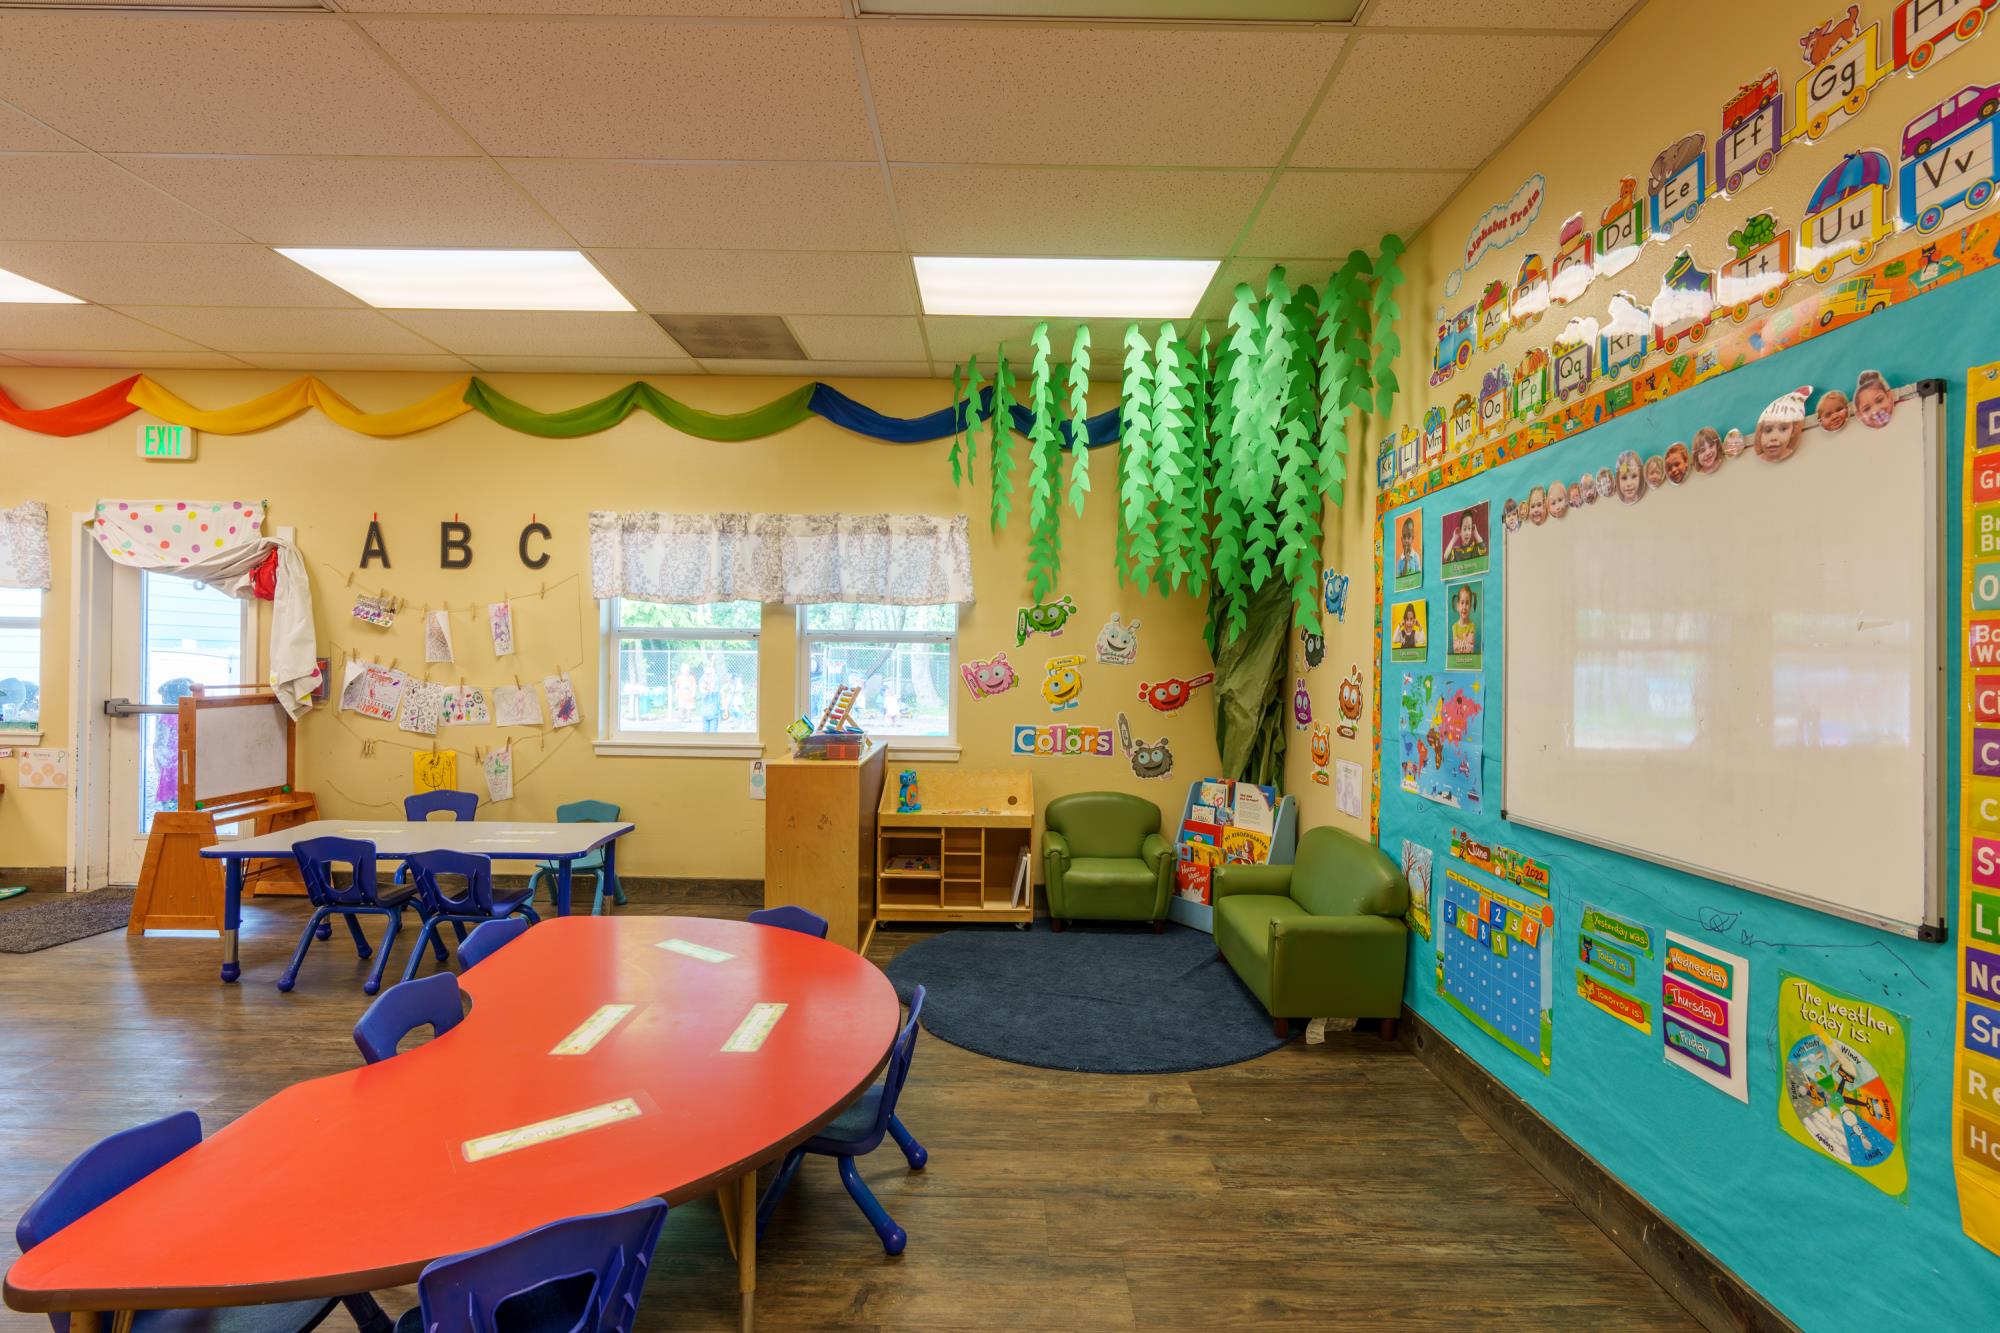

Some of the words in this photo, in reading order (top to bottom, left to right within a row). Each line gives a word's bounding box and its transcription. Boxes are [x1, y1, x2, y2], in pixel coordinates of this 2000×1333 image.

[1914, 0, 1959, 33] H
[1811, 60, 1856, 101] Gg
[1734, 115, 1764, 159] Ff
[1922, 148, 1974, 188] Vv
[1664, 178, 1690, 210] Ee
[1606, 212, 1632, 250] Dd
[1819, 207, 1864, 243] Uu
[1560, 357, 1585, 380] Qq
[1520, 378, 1537, 404] Pp
[1484, 400, 1501, 418] Oo
[1455, 415, 1471, 436] Nn
[145, 425, 184, 456] EXIT
[1382, 456, 1392, 474] Kk
[359, 522, 391, 569] A
[441, 522, 473, 569] B
[518, 522, 552, 570] C
[1017, 729, 1112, 754] Colors
[1232, 831, 1268, 850] KINDERGARTEN
[1468, 842, 1488, 859] June
[1525, 865, 1545, 881] 2022
[1594, 915, 1628, 939] Yesterday
[1596, 949, 1617, 968] Today
[1671, 951, 1728, 989] Wednesday
[1596, 988, 1629, 1012] Tomorrow
[1670, 988, 1718, 1025] Thursday
[1793, 982, 1821, 1006] The
[1827, 1002, 1895, 1036] weather
[1800, 1003, 1844, 1038] today
[1849, 1023, 1872, 1044] is:
[1679, 1031, 1710, 1059] Friday
[1841, 1045, 1861, 1064] Windy
